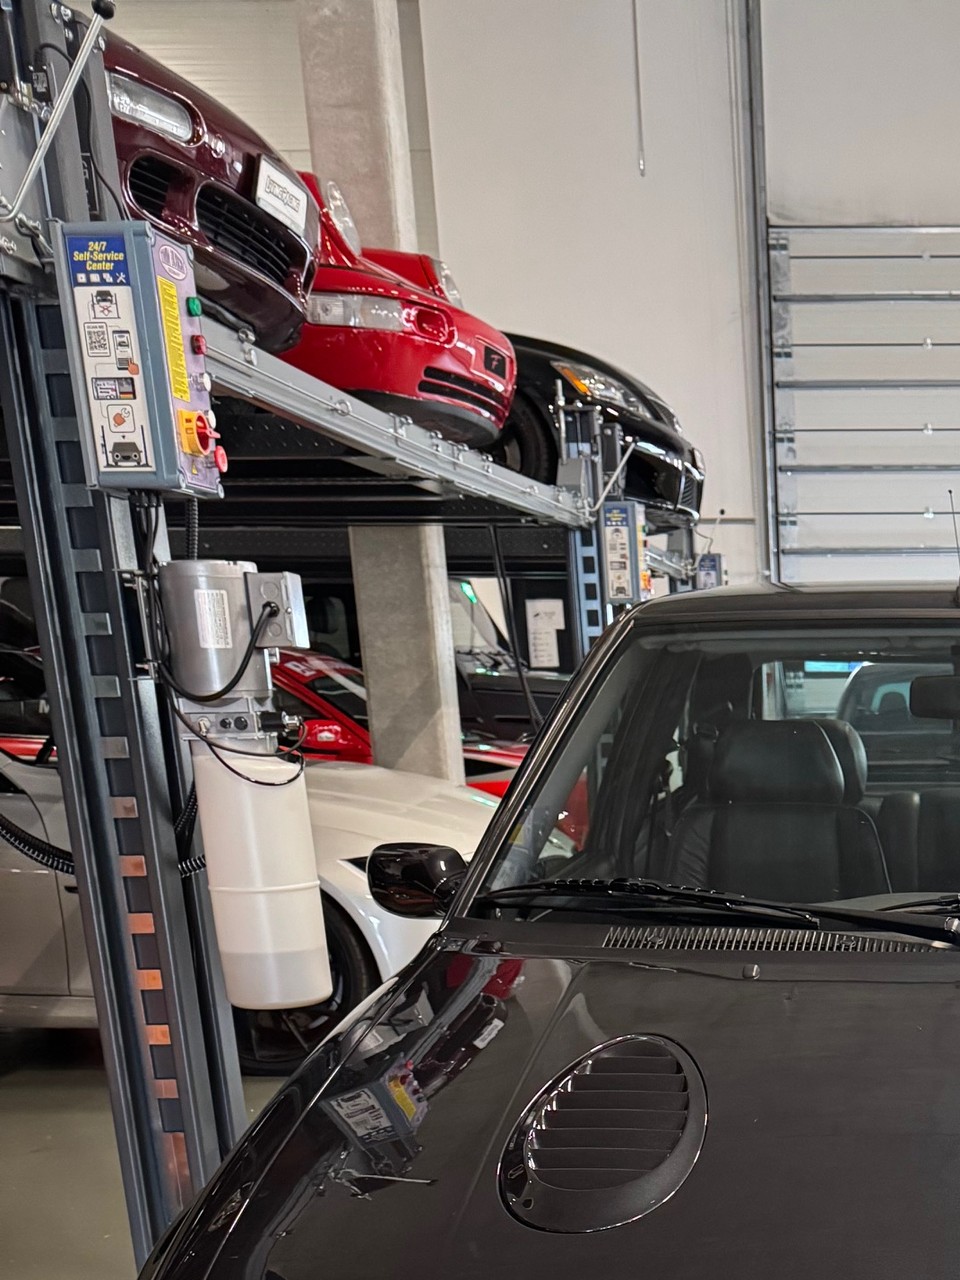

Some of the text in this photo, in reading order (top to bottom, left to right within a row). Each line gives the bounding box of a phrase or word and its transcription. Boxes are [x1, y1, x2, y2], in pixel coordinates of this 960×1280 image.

[88, 241, 107, 251] 24/7
[73, 250, 124, 261] Self-Service
[86, 260, 114, 270] Center
